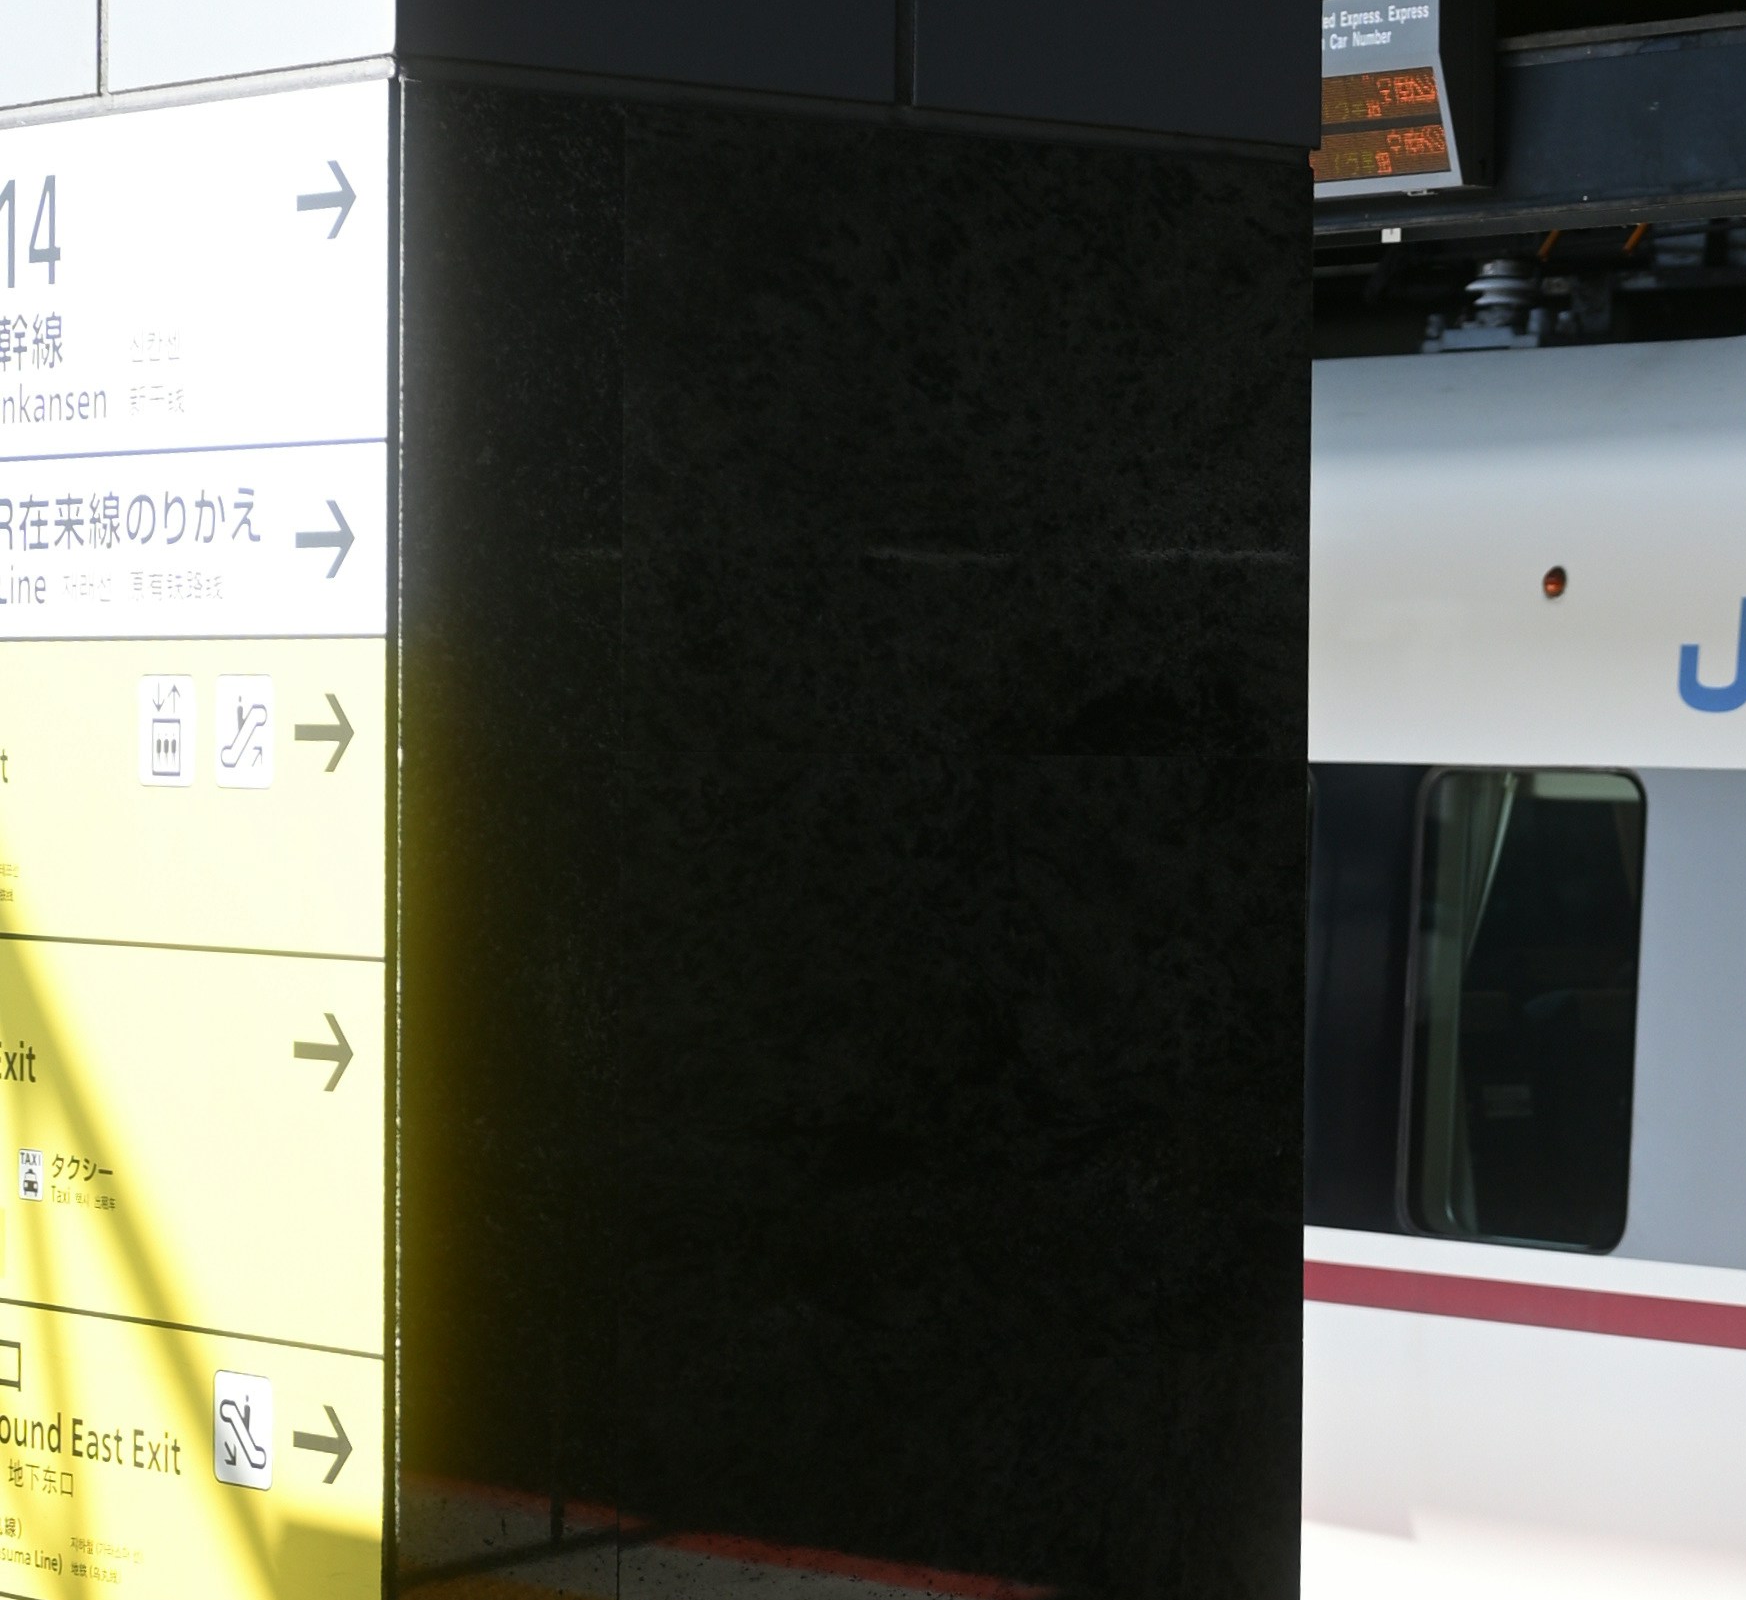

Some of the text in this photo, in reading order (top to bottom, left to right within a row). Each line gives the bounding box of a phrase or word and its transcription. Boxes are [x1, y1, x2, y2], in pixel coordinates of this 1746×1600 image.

[1388, 5, 1430, 24] Express
[1329, 33, 1348, 50] Car
[1352, 29, 1392, 47] Number
[2, 383, 108, 424] nkansen
[0, 1040, 37, 1083] xit
[20, 1151, 42, 1167] TAXI
[52, 1153, 114, 1182] タクシー
[51, 1185, 71, 1205] Taxi
[0, 1412, 182, 1476] ound East Exit
[8, 1457, 74, 1498] 地下东口
[35, 1549, 63, 1576] Line)
